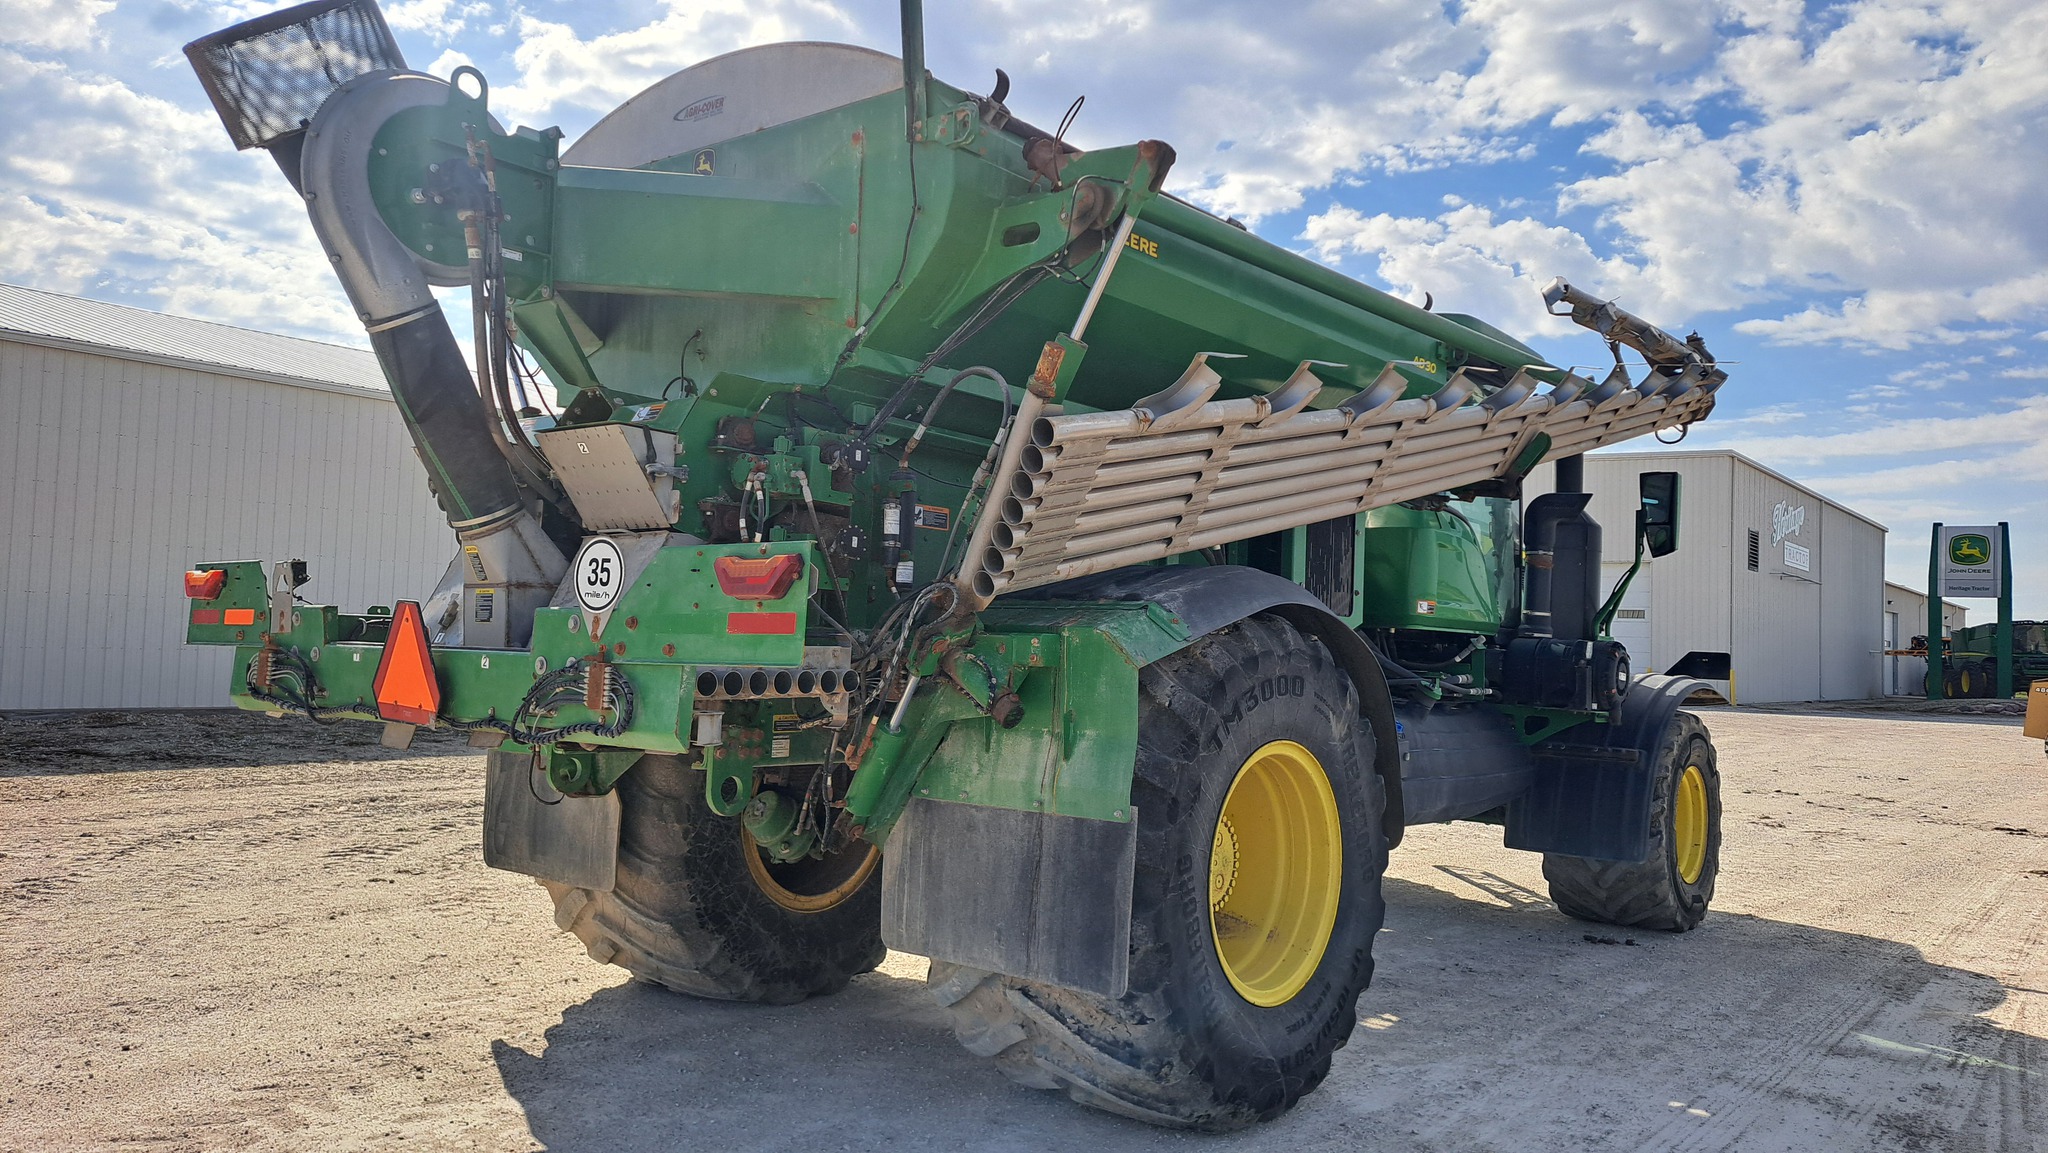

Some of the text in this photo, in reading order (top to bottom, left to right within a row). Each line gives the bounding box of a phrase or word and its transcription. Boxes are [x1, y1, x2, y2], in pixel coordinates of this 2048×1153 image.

[1125, 232, 1158, 258] ERE
[579, 443, 588, 453] 2
[587, 557, 611, 587] 35
[584, 590, 610, 600] mile/h
[1208, 674, 1305, 751] TM3000
[1176, 853, 1220, 1024] RELLEBORG
